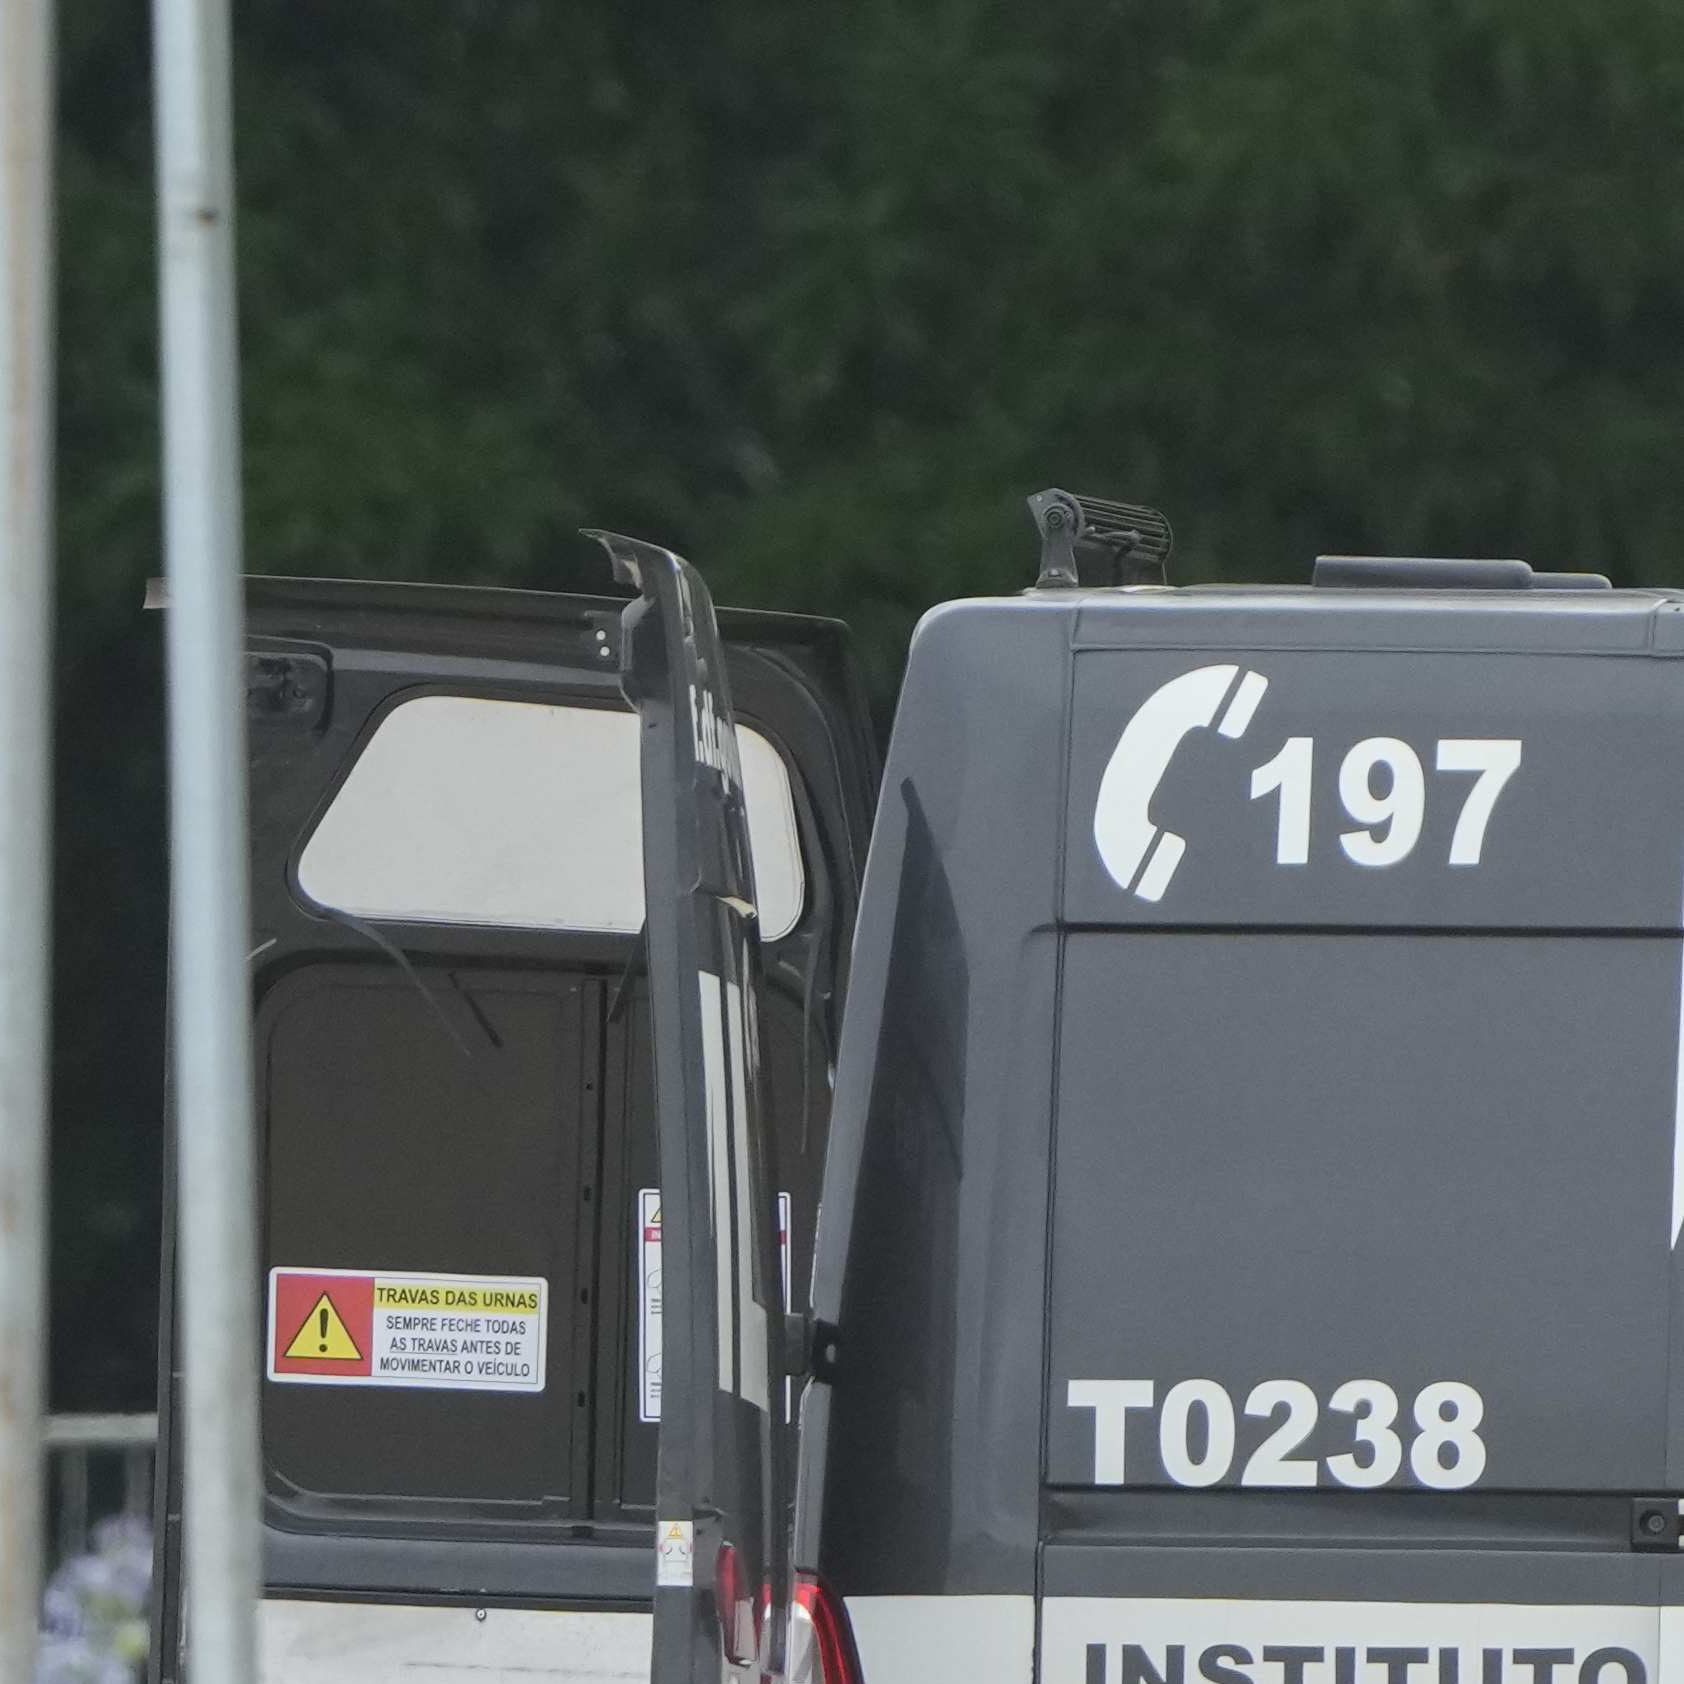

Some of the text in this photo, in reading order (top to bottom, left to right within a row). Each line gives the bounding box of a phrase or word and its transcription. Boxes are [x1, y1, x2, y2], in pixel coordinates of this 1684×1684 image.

[1249, 736, 1522, 867] 197
[376, 1287, 538, 1309] TRAVAS DAS URNAS
[386, 1315, 526, 1335] SEMPRE FECHE TODAS
[390, 1336, 521, 1356] AS TRAVAS ANTES DE
[379, 1357, 530, 1377] MOVIMENTAR O VEÍCULO
[1067, 1378, 1487, 1489] T0238
